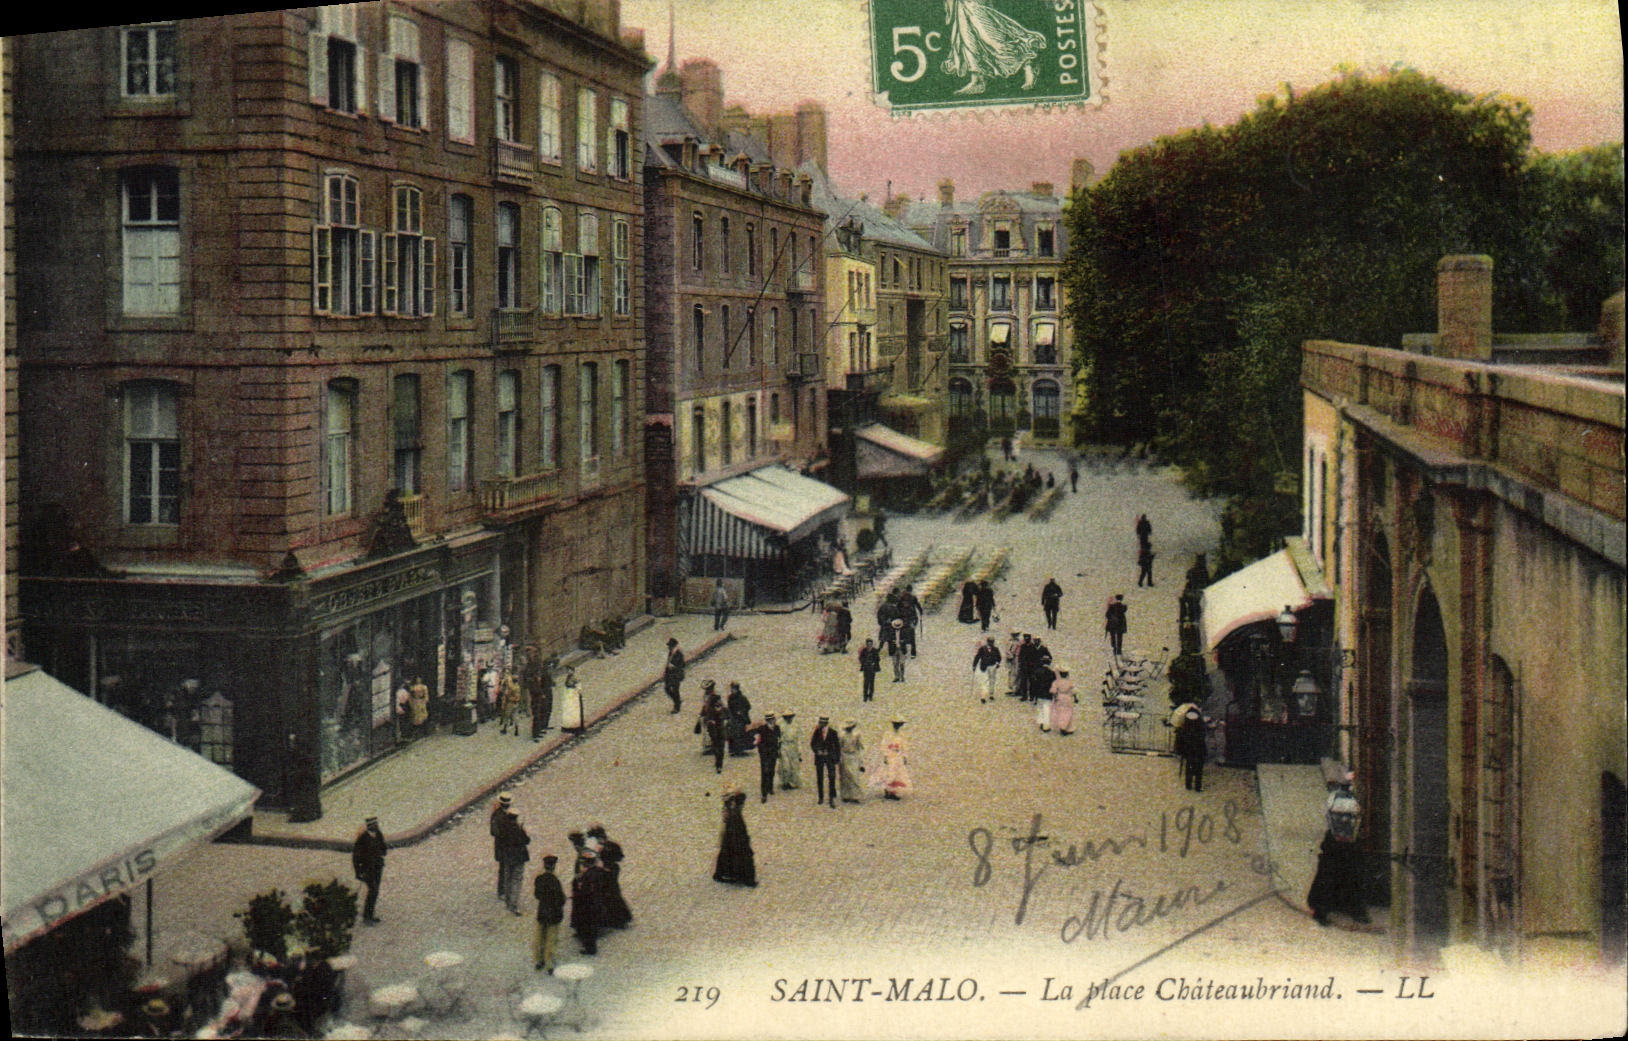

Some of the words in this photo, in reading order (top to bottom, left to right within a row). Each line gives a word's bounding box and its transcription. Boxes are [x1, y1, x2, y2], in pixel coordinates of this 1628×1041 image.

[1055, 0, 1079, 85] POSTES
[1159, 800, 1242, 858] 1908
[34, 850, 157, 927] PARIS
